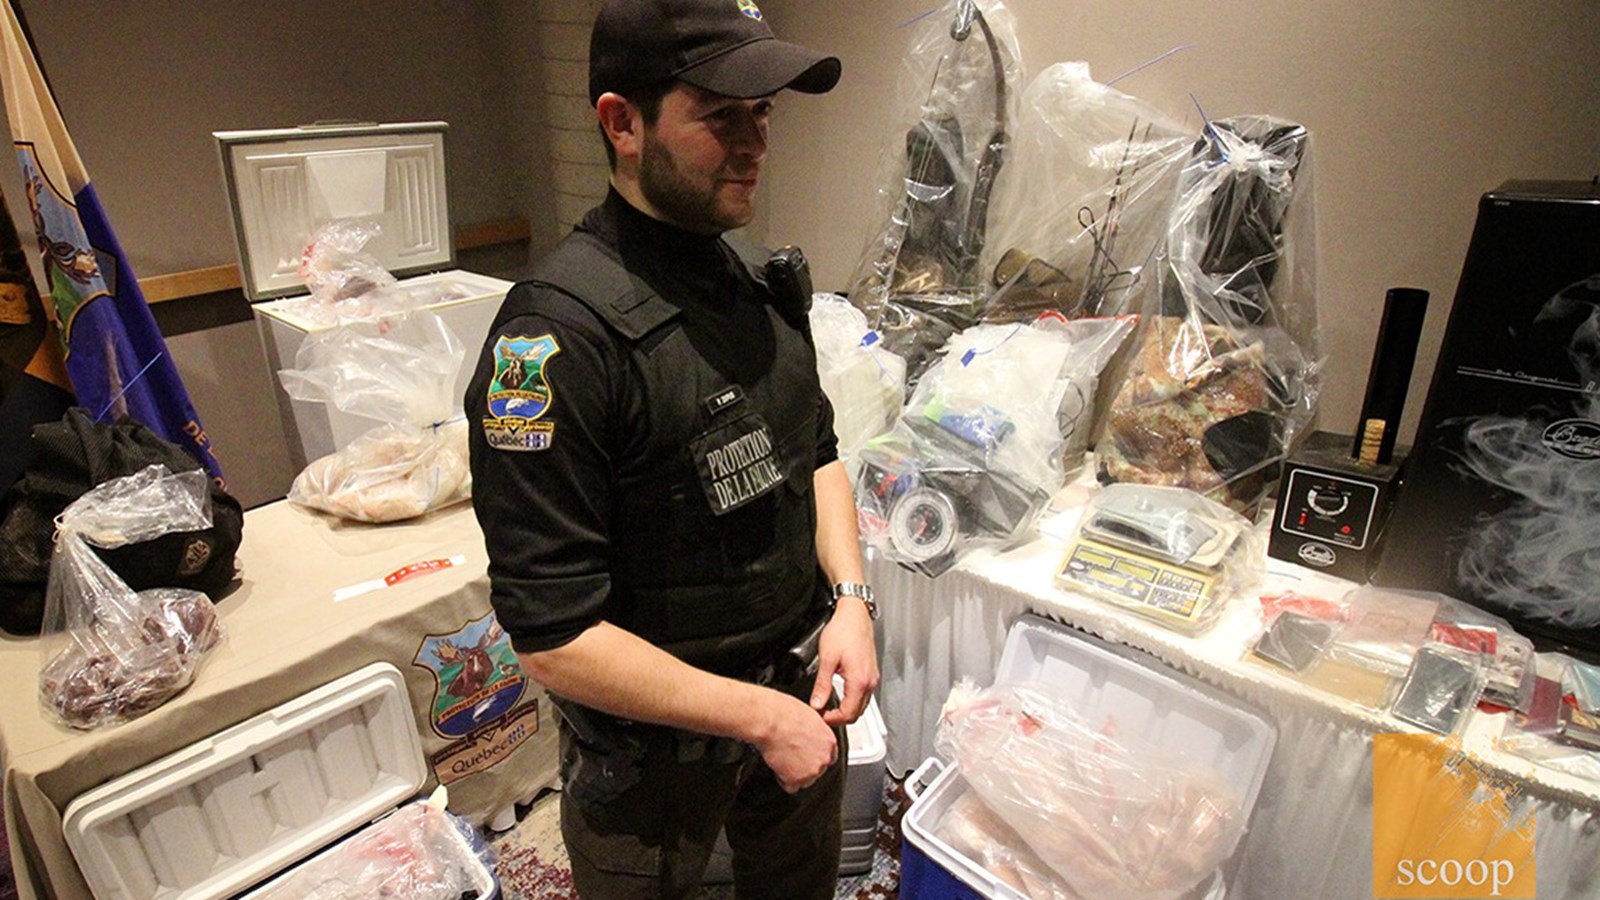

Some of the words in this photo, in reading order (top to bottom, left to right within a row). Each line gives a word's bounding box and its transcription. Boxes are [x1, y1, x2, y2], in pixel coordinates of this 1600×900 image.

[183, 420, 206, 446] DE
[706, 427, 772, 480] PROTECTION
[713, 477, 738, 509] DE
[732, 471, 755, 501] LA
[451, 739, 509, 774] Québec
